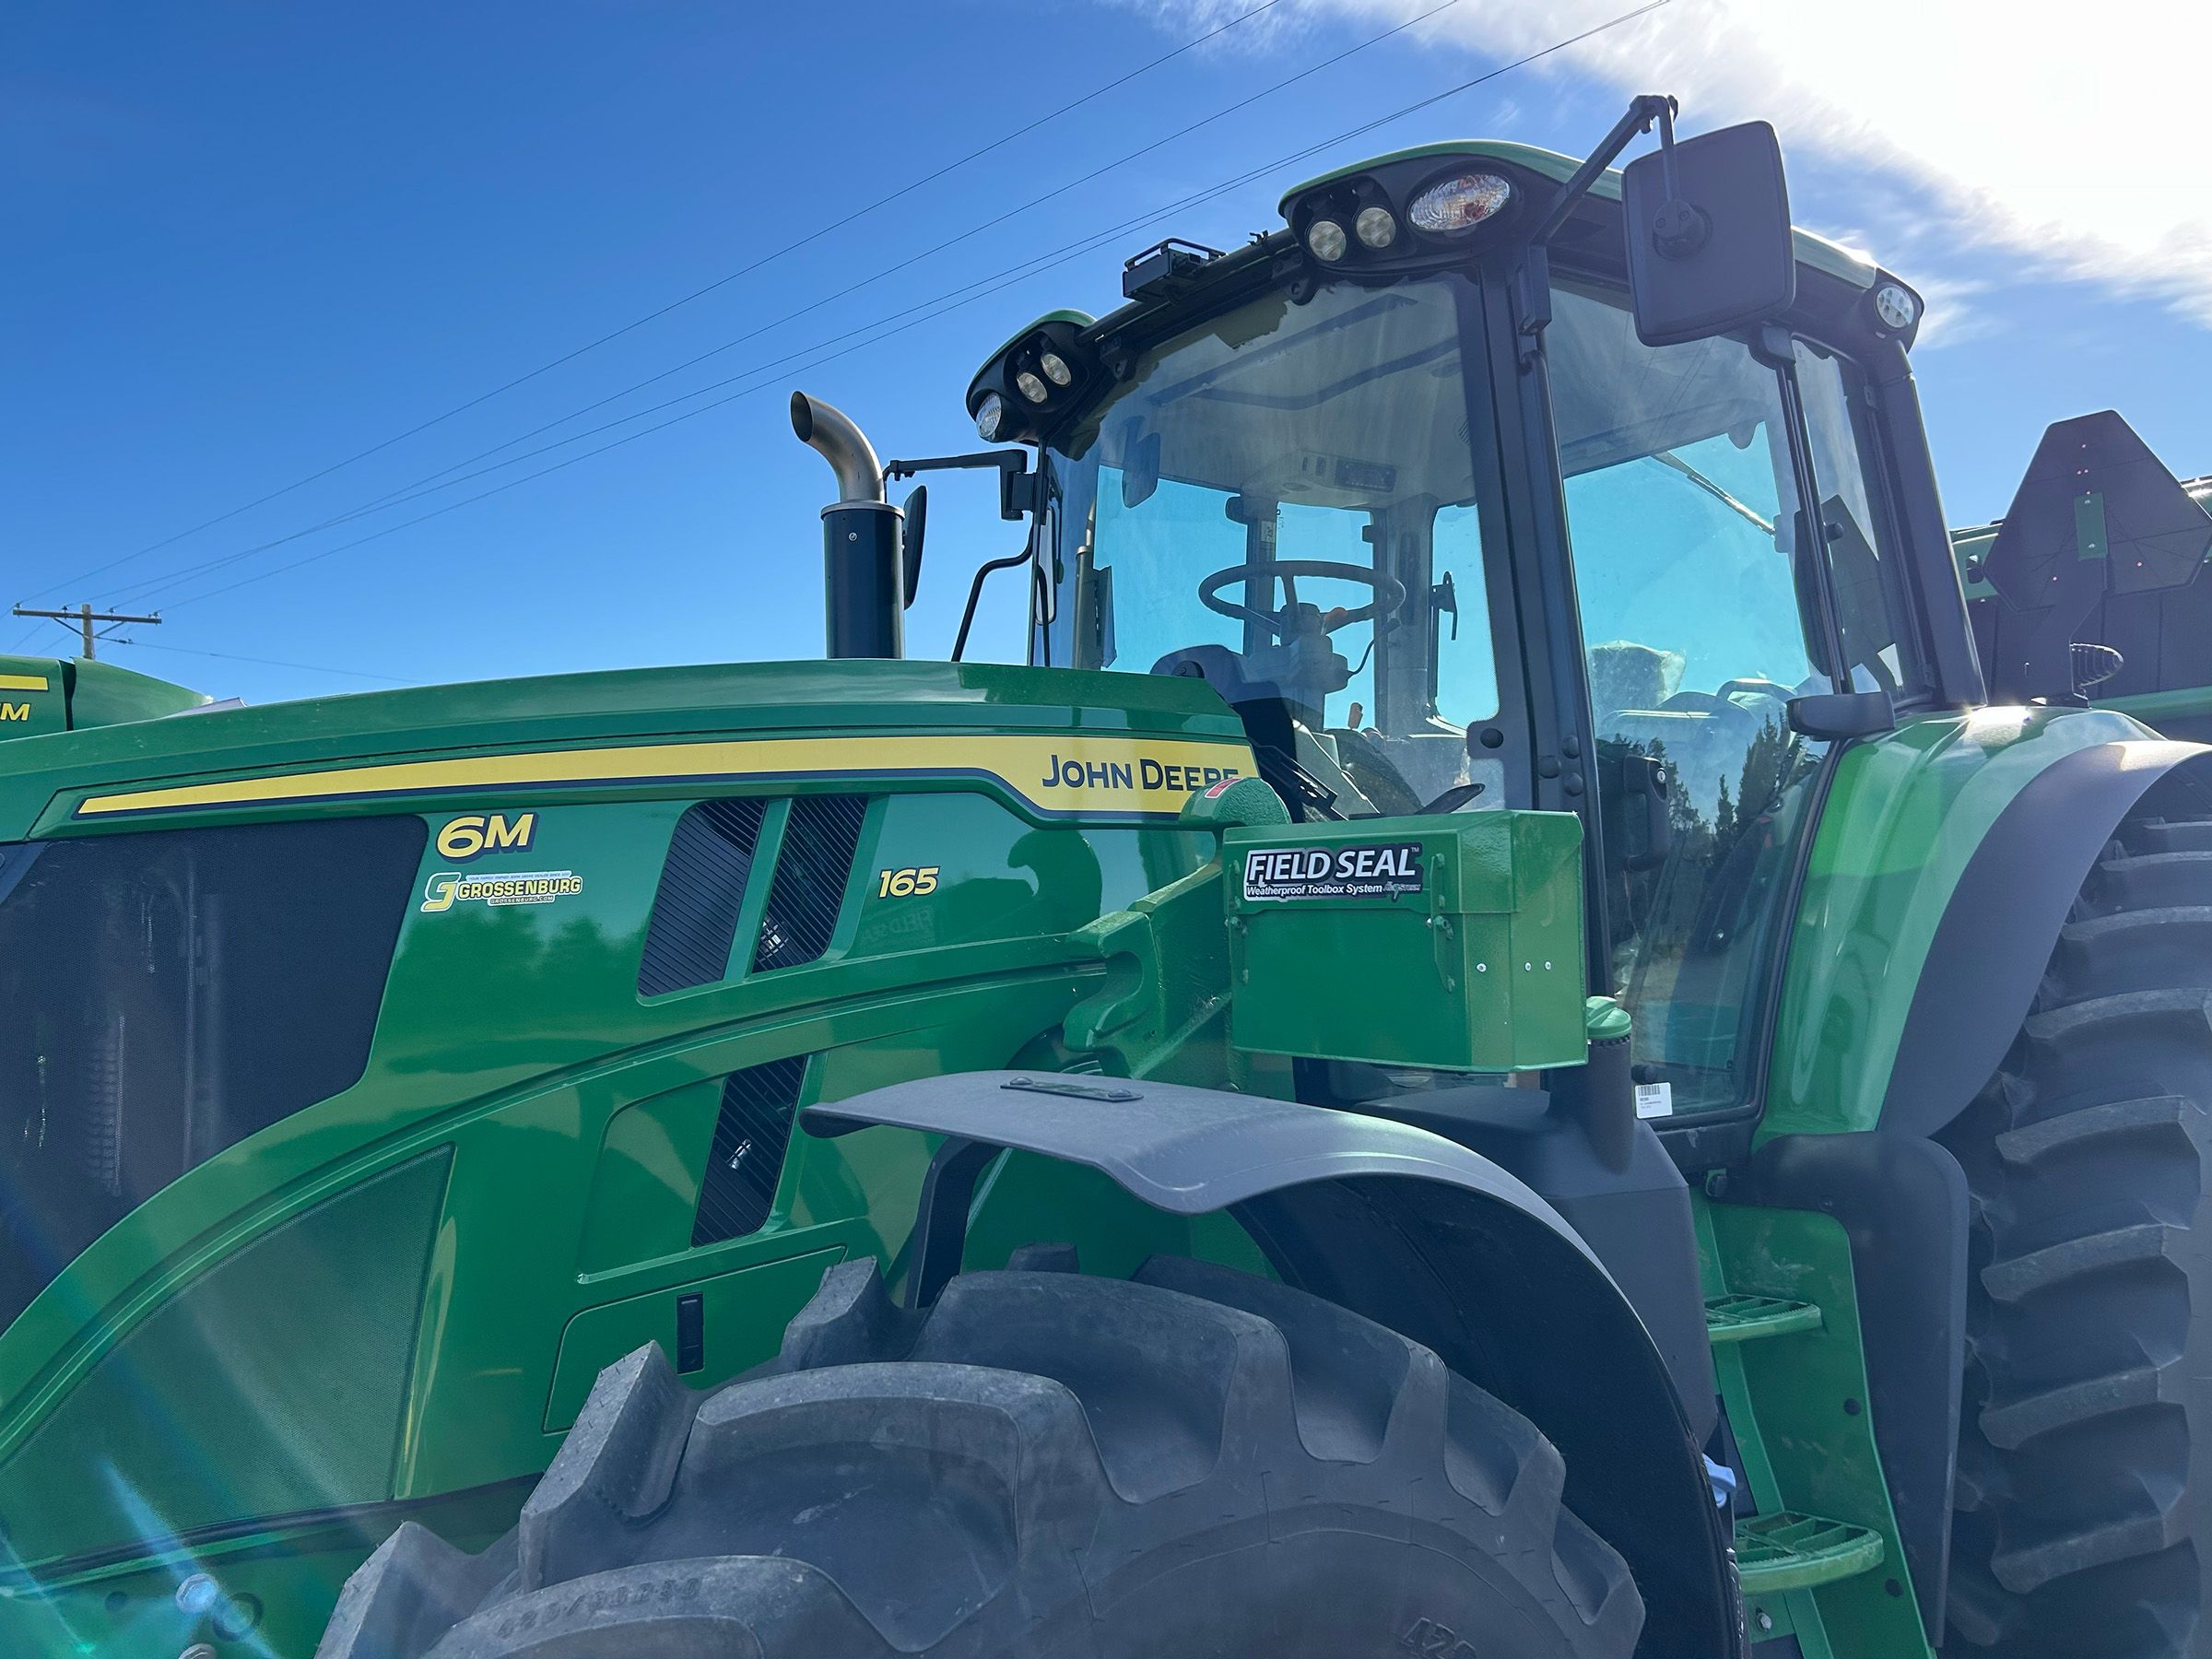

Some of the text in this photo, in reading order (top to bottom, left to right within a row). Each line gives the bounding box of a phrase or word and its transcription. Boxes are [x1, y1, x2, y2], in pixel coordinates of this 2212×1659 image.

[1041, 754, 1134, 790] JOHN
[437, 813, 536, 861] 6M
[1248, 853, 1332, 882] FIELD
[1336, 848, 1416, 878] SEAL
[458, 878, 582, 900] GROSSENBURG
[878, 867, 939, 899] 165
[1247, 883, 1306, 898] Weatherproof
[1307, 884, 1345, 895] Toolbox
[1346, 883, 1382, 896] System
